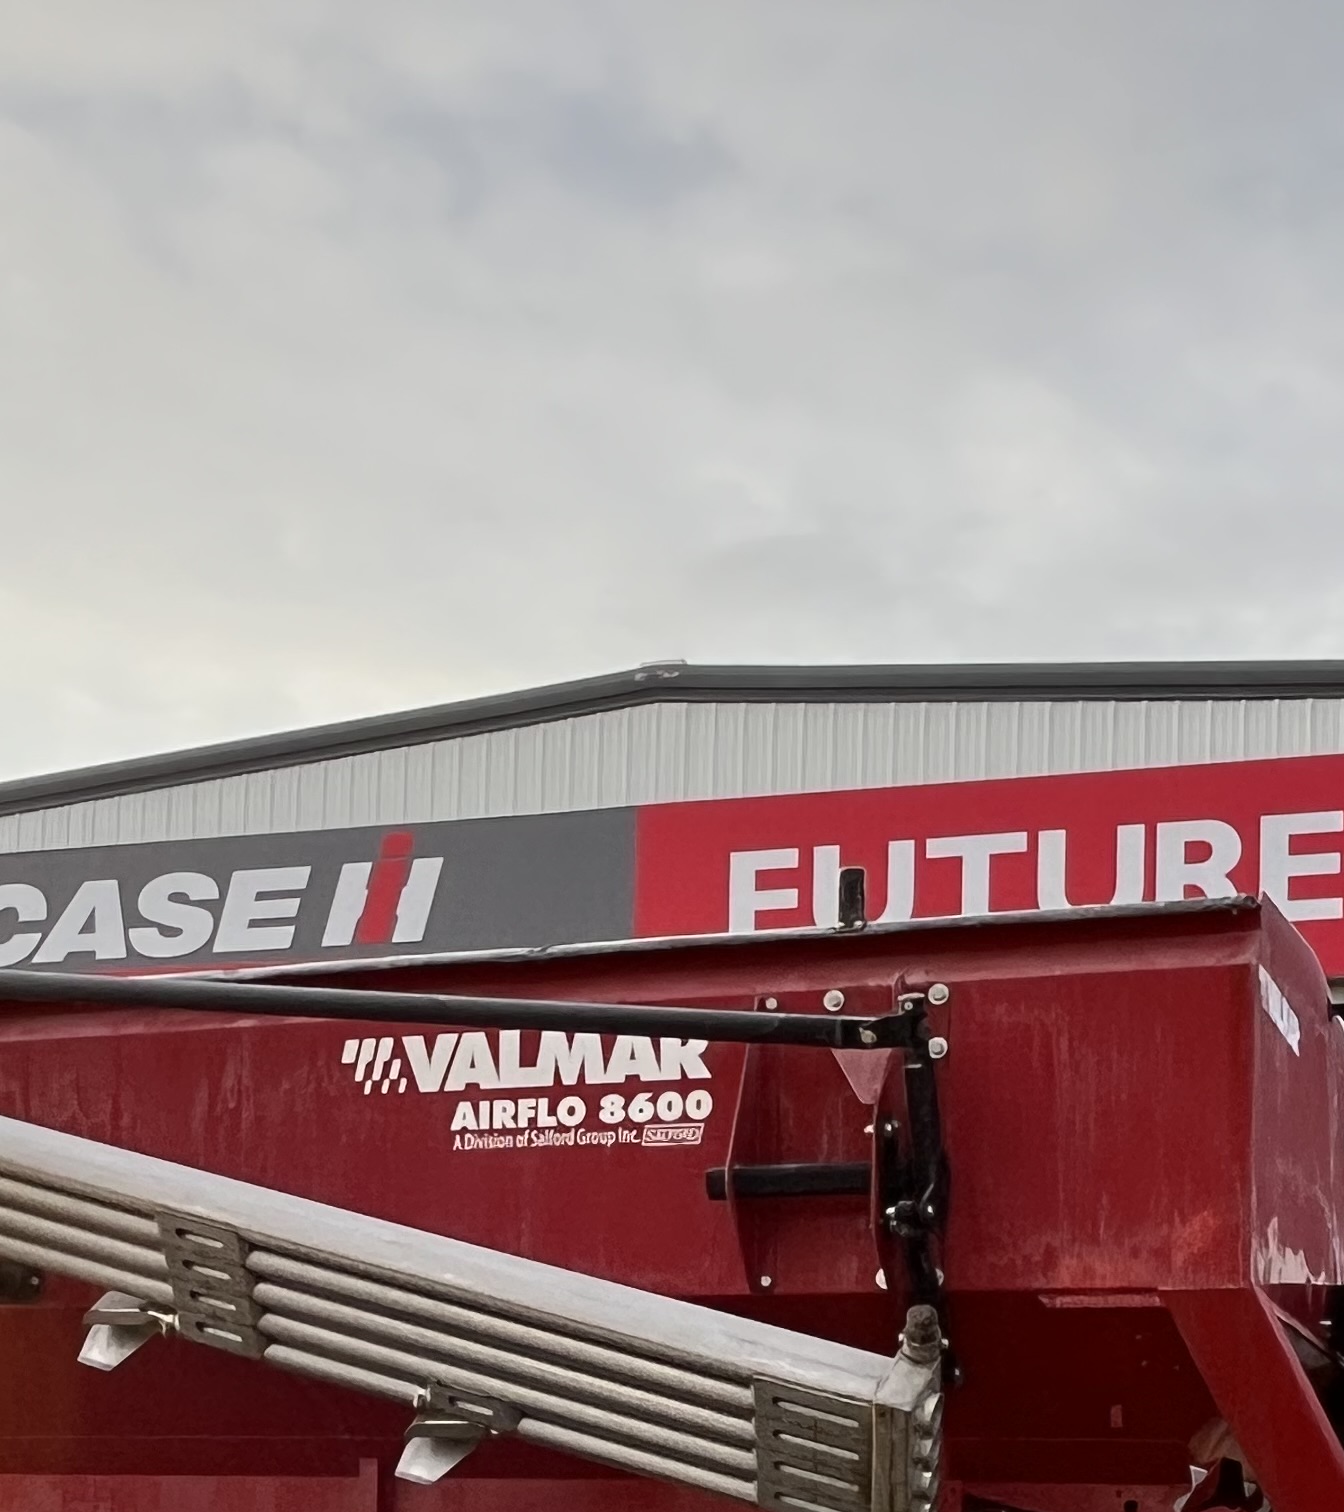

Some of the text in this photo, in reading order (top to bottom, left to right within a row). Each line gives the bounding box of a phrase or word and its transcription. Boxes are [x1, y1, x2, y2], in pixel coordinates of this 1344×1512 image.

[729, 811, 1344, 932] FUTURE
[402, 1029, 712, 1093] VALMAR
[450, 1089, 714, 1131] AIRFLO 8600
[452, 1134, 464, 1151] A
[464, 1132, 514, 1151] Division
[516, 1129, 531, 1148] of
[530, 1128, 575, 1148] Salford
[576, 1128, 616, 1148] Group
